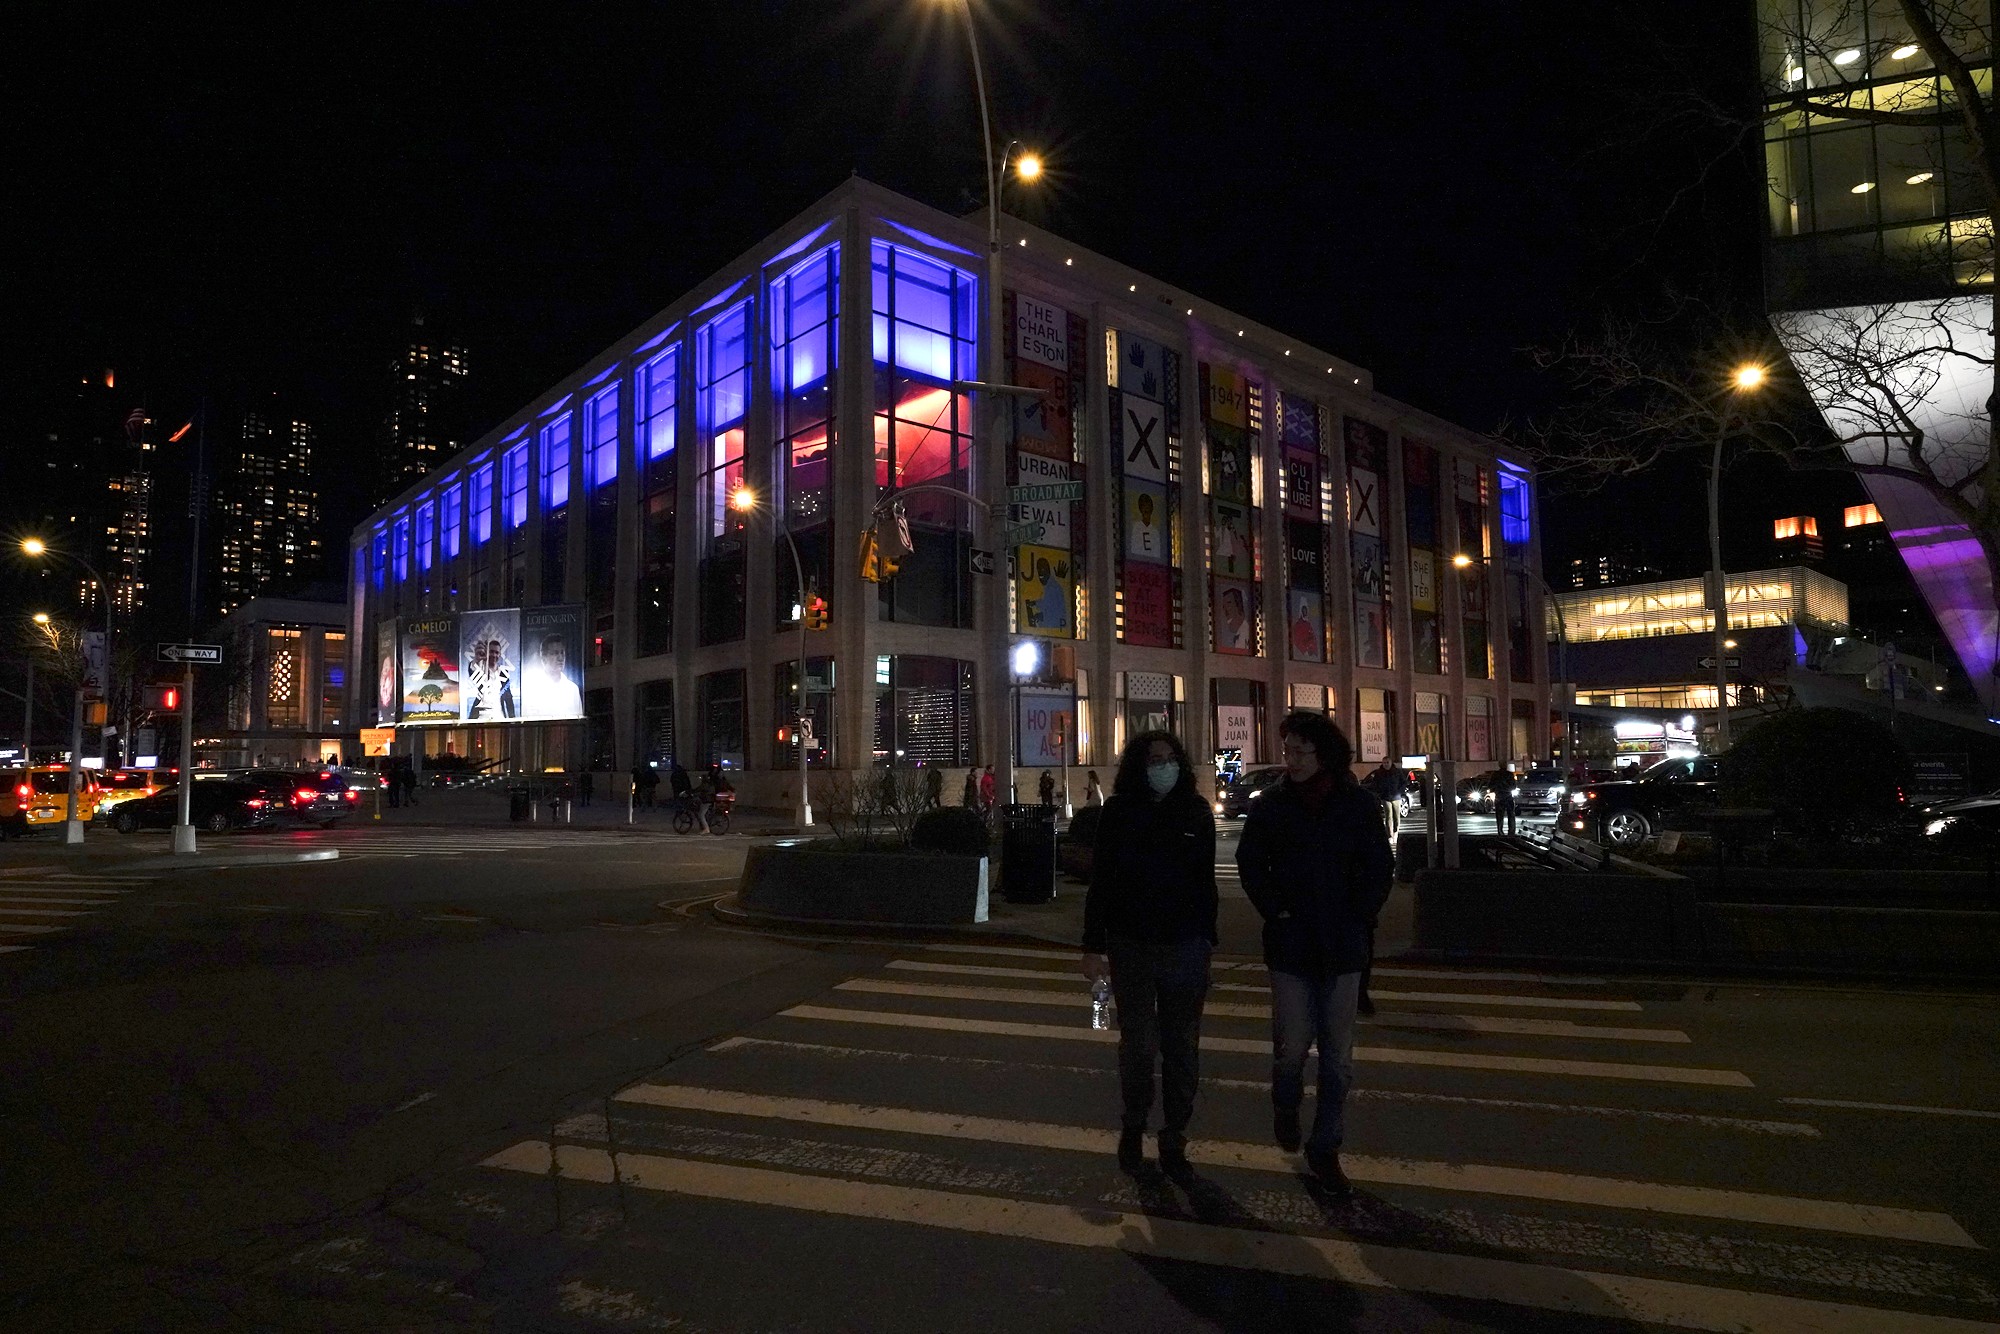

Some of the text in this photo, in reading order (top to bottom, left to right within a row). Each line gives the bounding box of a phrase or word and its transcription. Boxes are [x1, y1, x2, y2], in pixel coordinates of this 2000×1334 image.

[1025, 302, 1053, 324] THE
[1018, 316, 1063, 343] CHARL
[1023, 336, 1064, 361] ESTON
[1210, 384, 1242, 411] 1947
[1127, 408, 1161, 470] X
[1019, 456, 1068, 481] URBAN
[1013, 484, 1078, 502] BROADWAY
[1021, 505, 1066, 527] EWAL
[1291, 547, 1317, 565] LOVE
[408, 621, 452, 635] CAMELOT
[527, 614, 577, 625] LOHENGRIN
[168, 649, 186, 658] ONE
[1228, 716, 1246, 727] SAN
[1366, 721, 1381, 730] SAN
[1225, 730, 1249, 741] JUAN
[1364, 733, 1383, 742] JUAN
[1366, 746, 1381, 755] HILL
